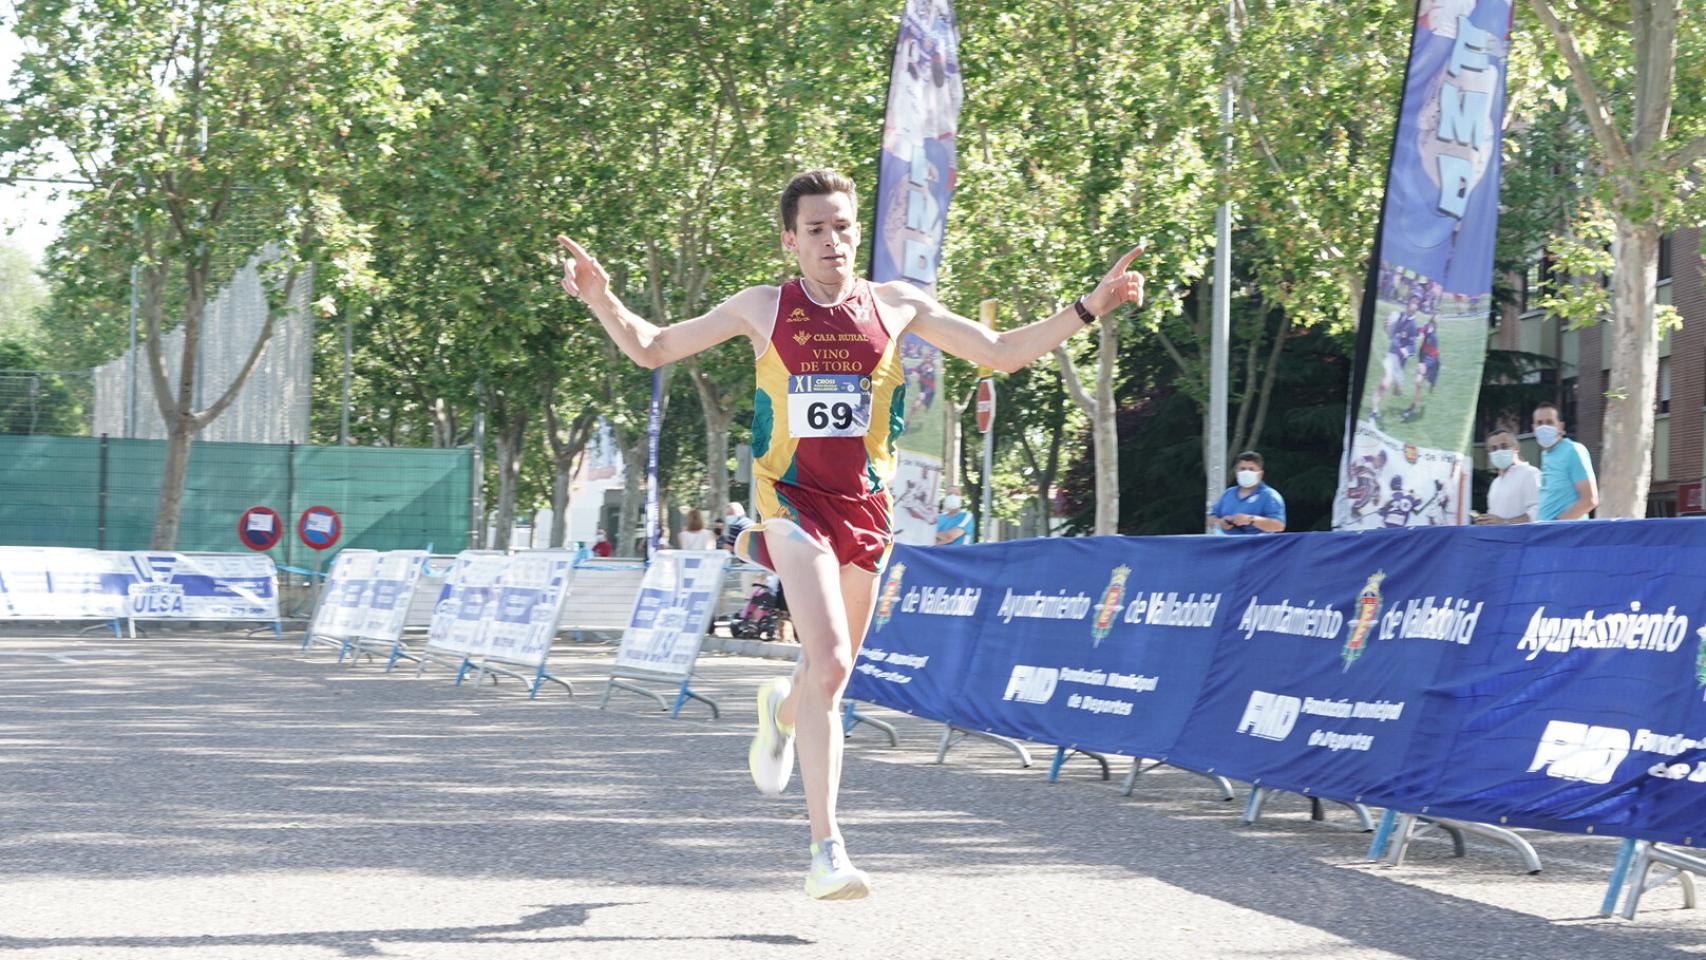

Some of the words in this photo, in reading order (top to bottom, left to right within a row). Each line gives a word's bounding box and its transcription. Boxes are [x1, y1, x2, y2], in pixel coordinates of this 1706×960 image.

[812, 349, 850, 359] VINO
[813, 334, 836, 342] CAJA
[838, 334, 870, 342] RURAL
[801, 361, 820, 372] DE
[821, 361, 863, 372] TORO
[794, 375, 813, 393] XI
[807, 402, 853, 430] 69
[133, 595, 183, 613] ULSA
[901, 585, 921, 613] de
[918, 586, 982, 617] Valladolid
[997, 587, 1092, 625] Ayuntamiento
[1124, 591, 1148, 624] de
[1144, 592, 1222, 627] Valladolid
[1238, 595, 1344, 641] Ayuntamiento
[1378, 601, 1400, 641] de
[1398, 596, 1485, 645] Valladolid
[1516, 601, 1689, 661] Ayuntamiento
[1002, 664, 1060, 705] FMD
[1236, 690, 1302, 742] FMD
[1525, 719, 1632, 785] FMD
